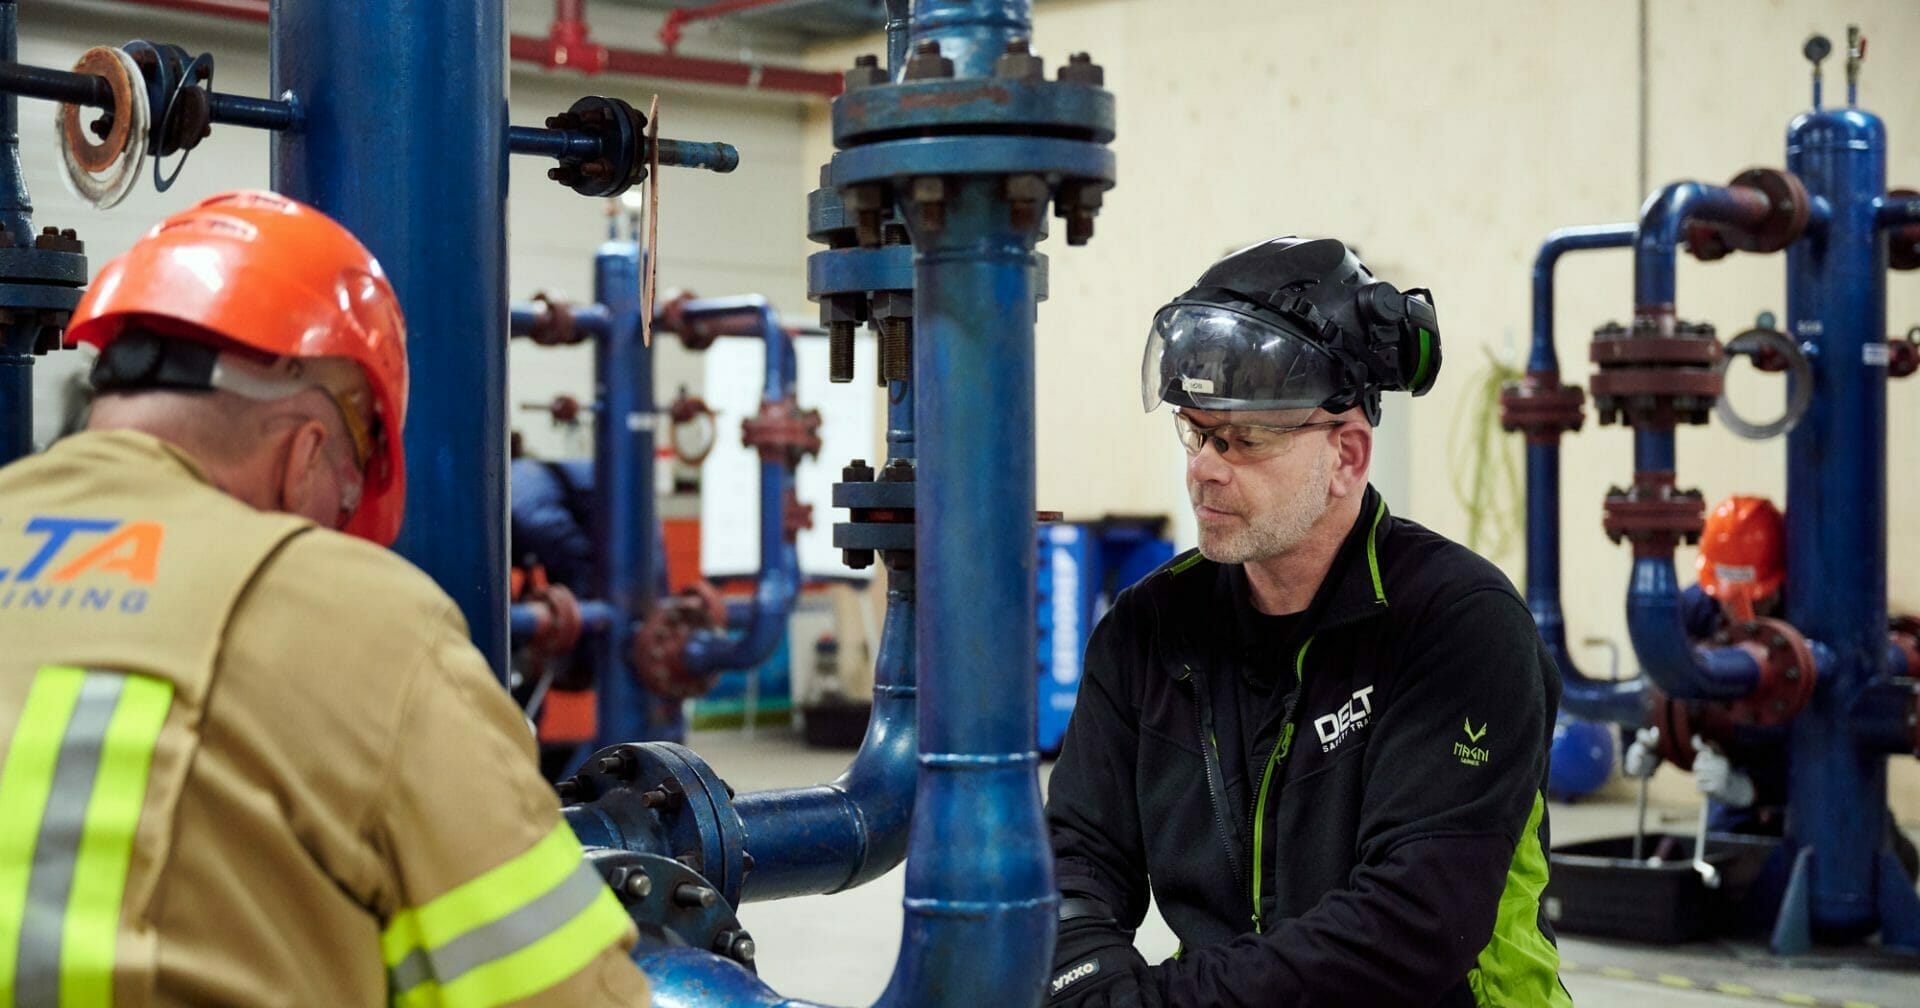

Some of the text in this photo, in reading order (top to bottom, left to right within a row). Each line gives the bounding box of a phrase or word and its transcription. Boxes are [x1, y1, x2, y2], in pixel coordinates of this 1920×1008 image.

[0, 517, 164, 584] TA
[1314, 685, 1374, 744] DELT
[1453, 742, 1489, 762] MAGNI
[1053, 963, 1094, 991] OXXA
